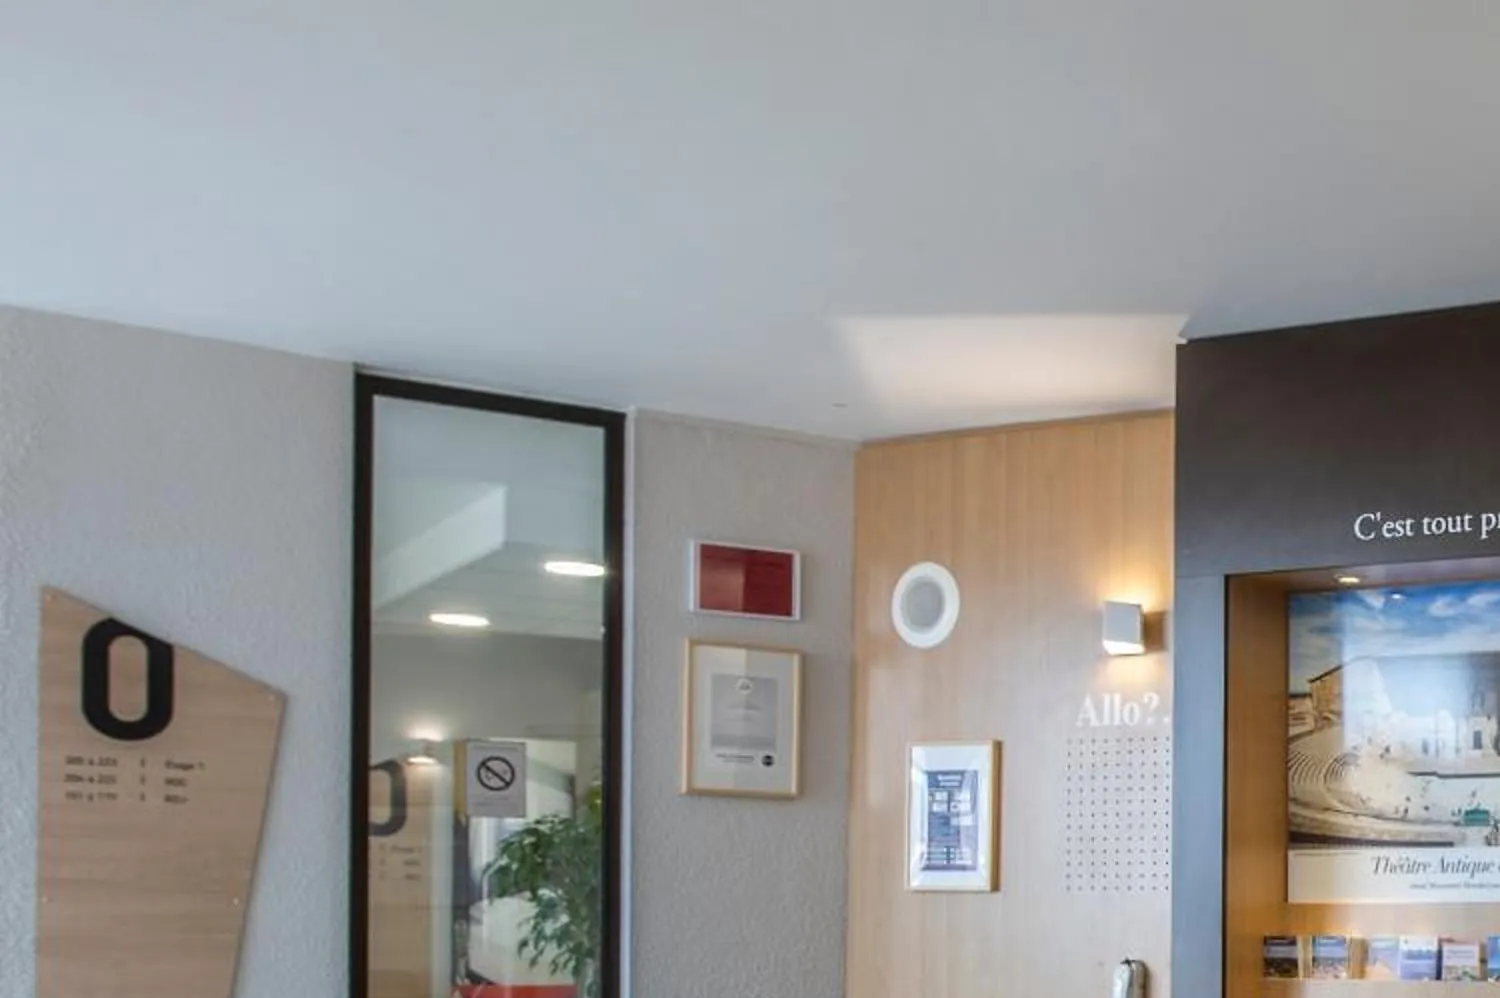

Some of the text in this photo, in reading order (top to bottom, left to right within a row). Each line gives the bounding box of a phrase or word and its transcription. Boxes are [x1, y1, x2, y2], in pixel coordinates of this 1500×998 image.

[1353, 511, 1415, 541] C'est
[1423, 512, 1473, 536] tout
[1439, 854, 1495, 879] Antique
